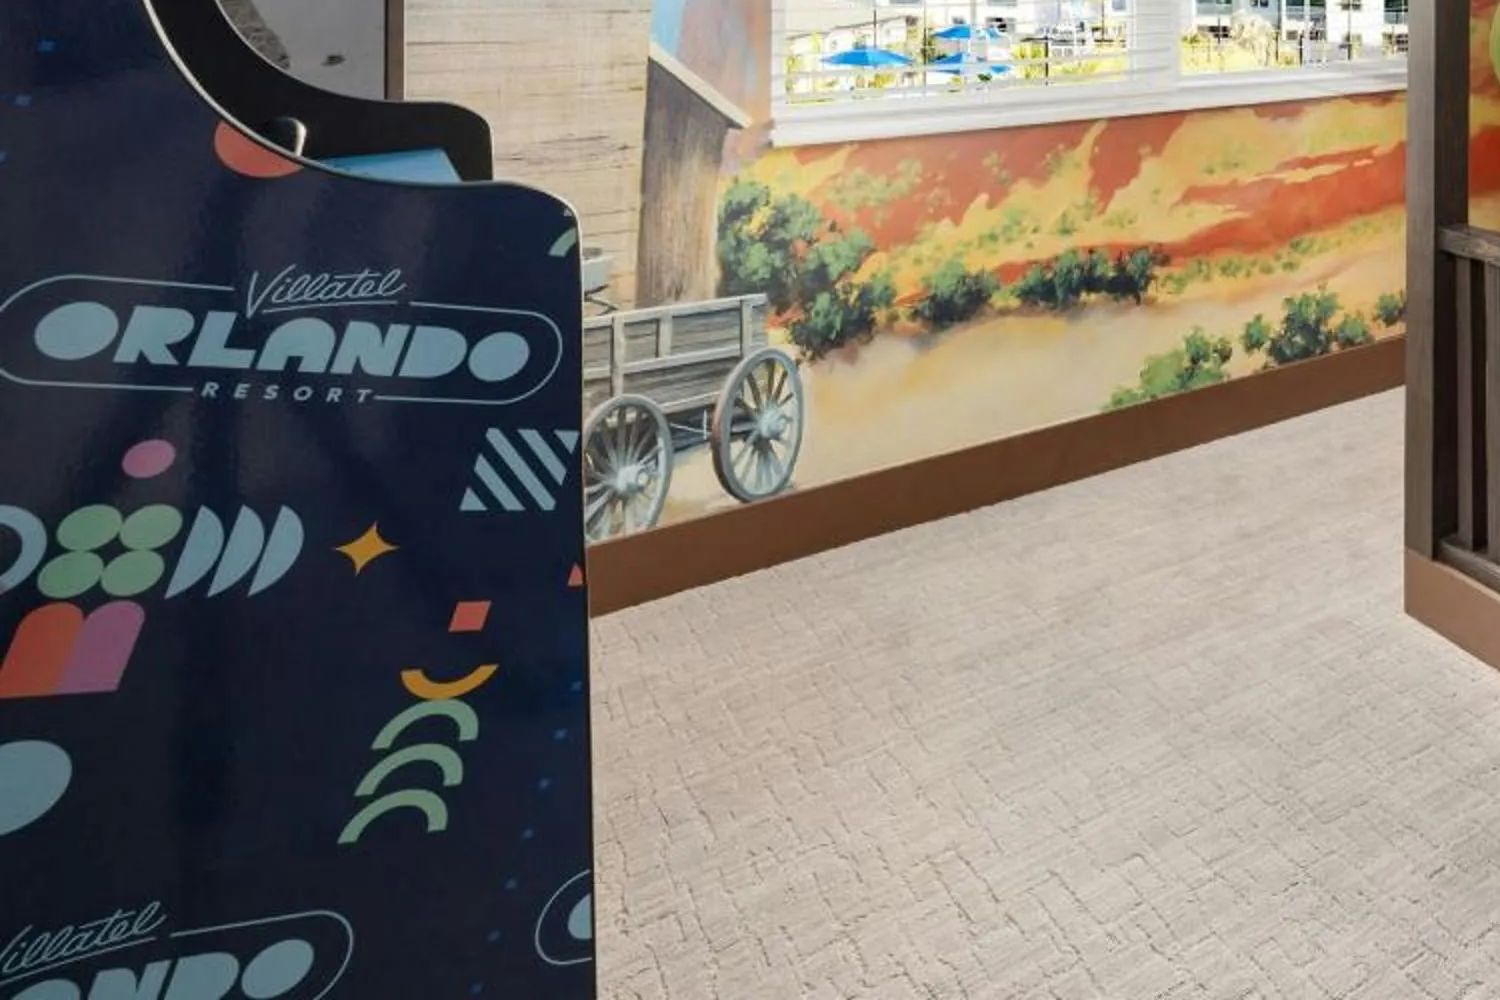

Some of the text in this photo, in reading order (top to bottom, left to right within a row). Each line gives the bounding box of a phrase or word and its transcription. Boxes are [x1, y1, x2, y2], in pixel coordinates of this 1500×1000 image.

[246, 264, 406, 318] Villatel
[34, 302, 529, 381] ORLANDO
[201, 381, 373, 402] RESORT
